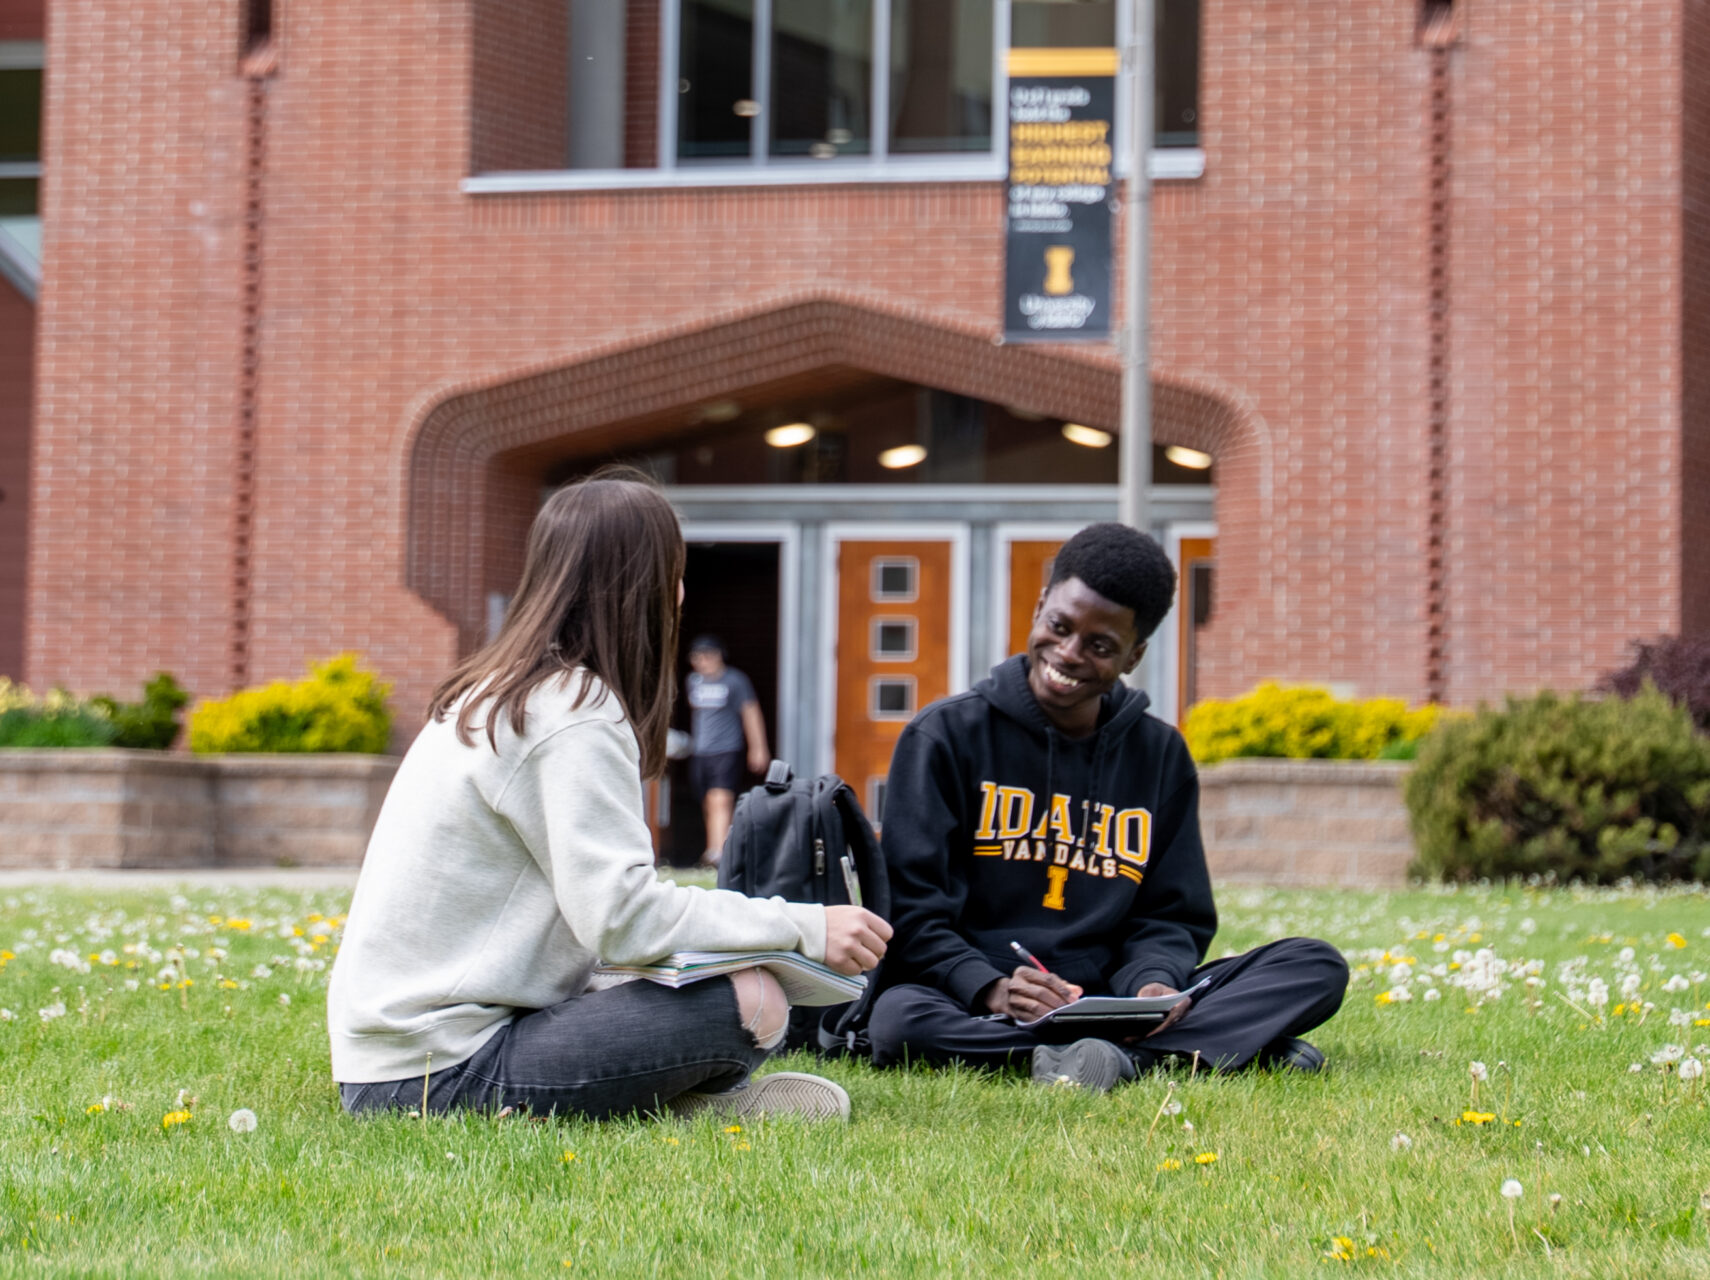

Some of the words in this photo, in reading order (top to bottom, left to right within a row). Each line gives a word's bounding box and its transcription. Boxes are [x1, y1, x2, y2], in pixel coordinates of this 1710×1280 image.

[974, 780, 1152, 866] IDAHO
[1002, 839, 1118, 878] VANDALS
[1042, 865, 1069, 910] I
